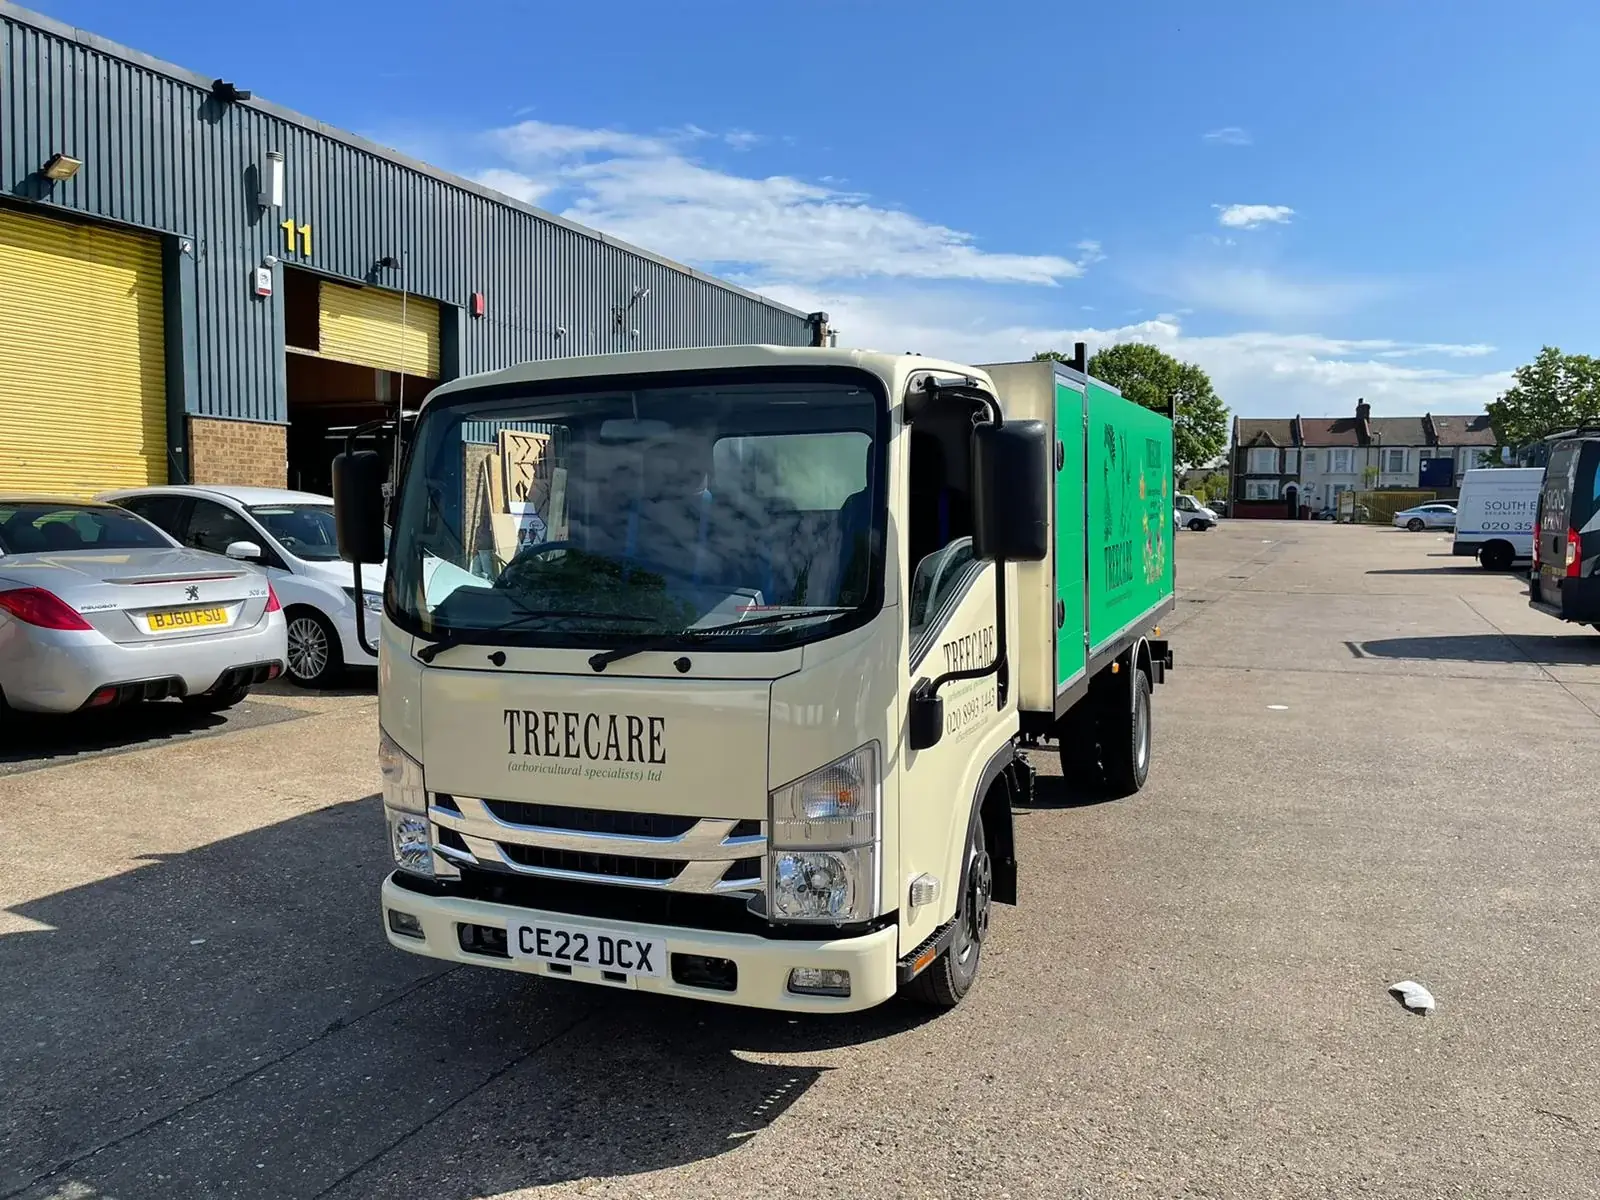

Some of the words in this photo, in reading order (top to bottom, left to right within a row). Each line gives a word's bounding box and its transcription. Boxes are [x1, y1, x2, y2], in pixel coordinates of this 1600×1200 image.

[281, 218, 312, 256] 11
[1484, 500, 1526, 511] SOUTH
[1530, 500, 1537, 511] E
[1481, 521, 1510, 531] 020
[1514, 521, 1532, 531] 35
[155, 612, 193, 628] BJ60
[195, 608, 222, 623] FSU
[943, 625, 994, 687] TREECARE
[946, 708, 960, 735] 020
[503, 709, 667, 764] TREECARE
[507, 760, 582, 777] (arboricultural
[584, 765, 644, 783] specialists)
[647, 769, 663, 782] ltd
[518, 925, 590, 963] CE22
[597, 935, 654, 972] DCX
